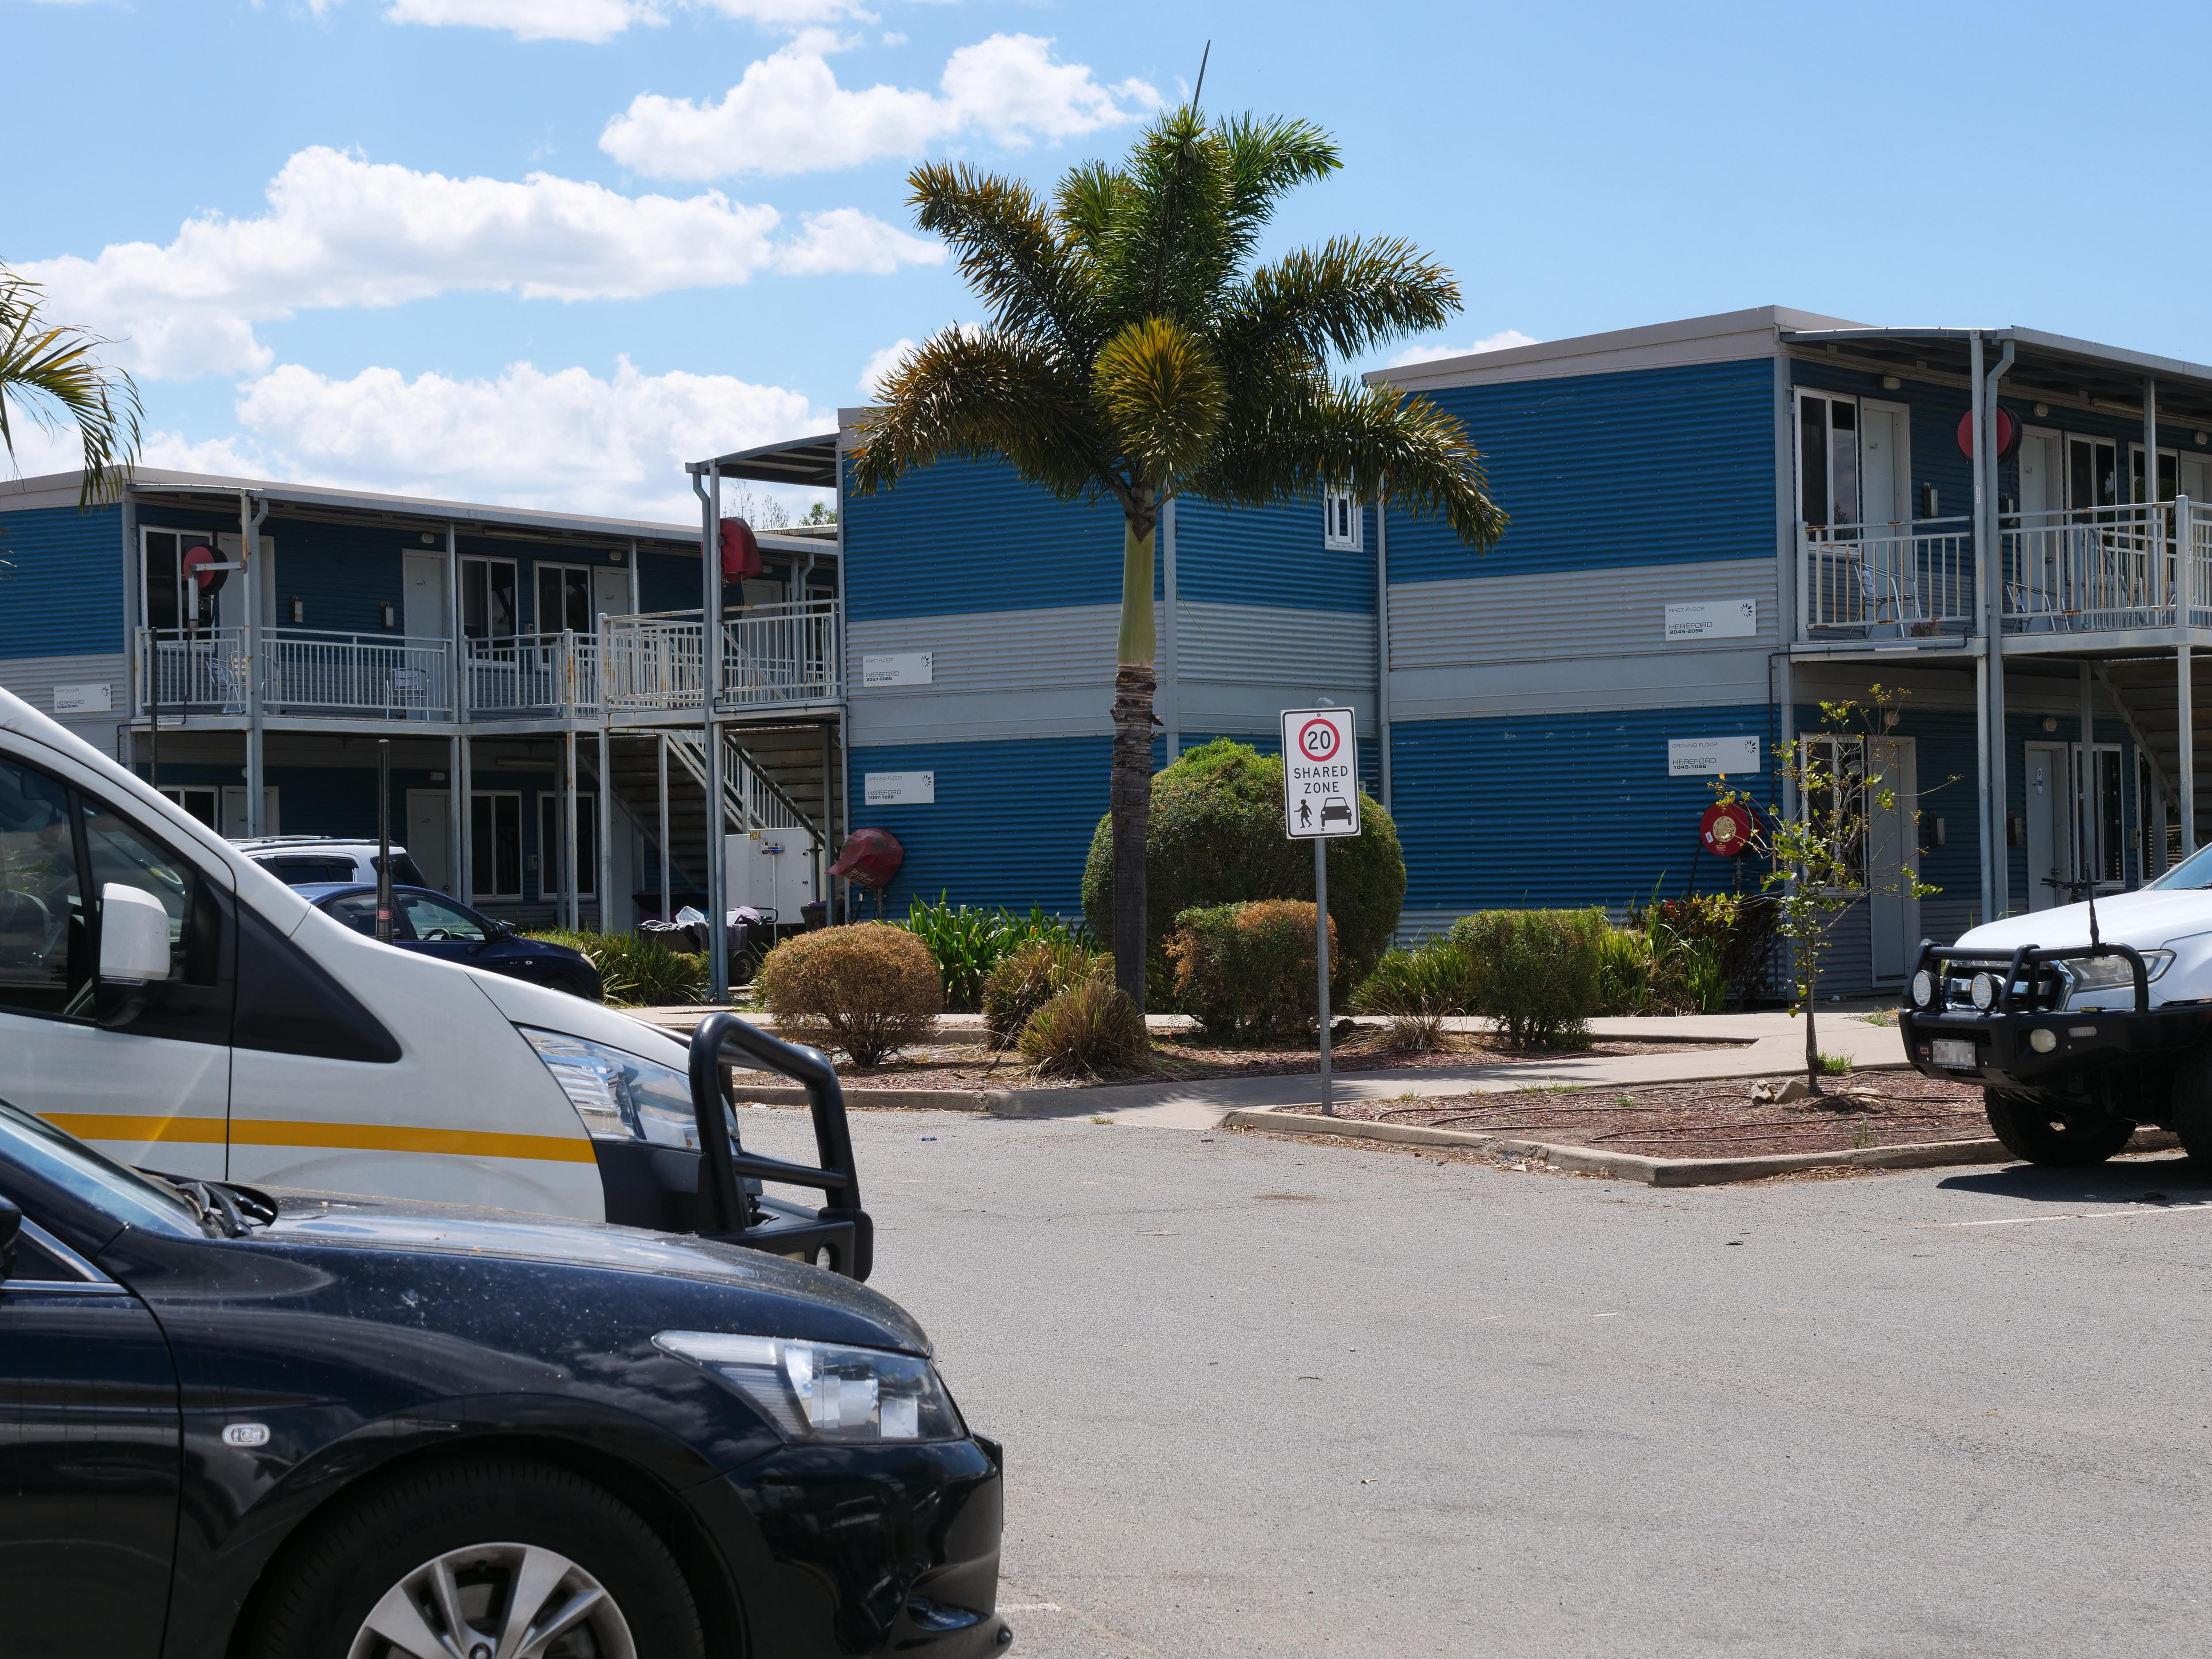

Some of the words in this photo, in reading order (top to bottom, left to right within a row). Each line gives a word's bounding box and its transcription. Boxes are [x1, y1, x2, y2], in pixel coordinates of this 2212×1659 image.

[1307, 730, 1331, 750] 20
[1294, 766, 1348, 779] SHARED
[1304, 782, 1340, 794] ZONE
[750, 831, 761, 840] H24
